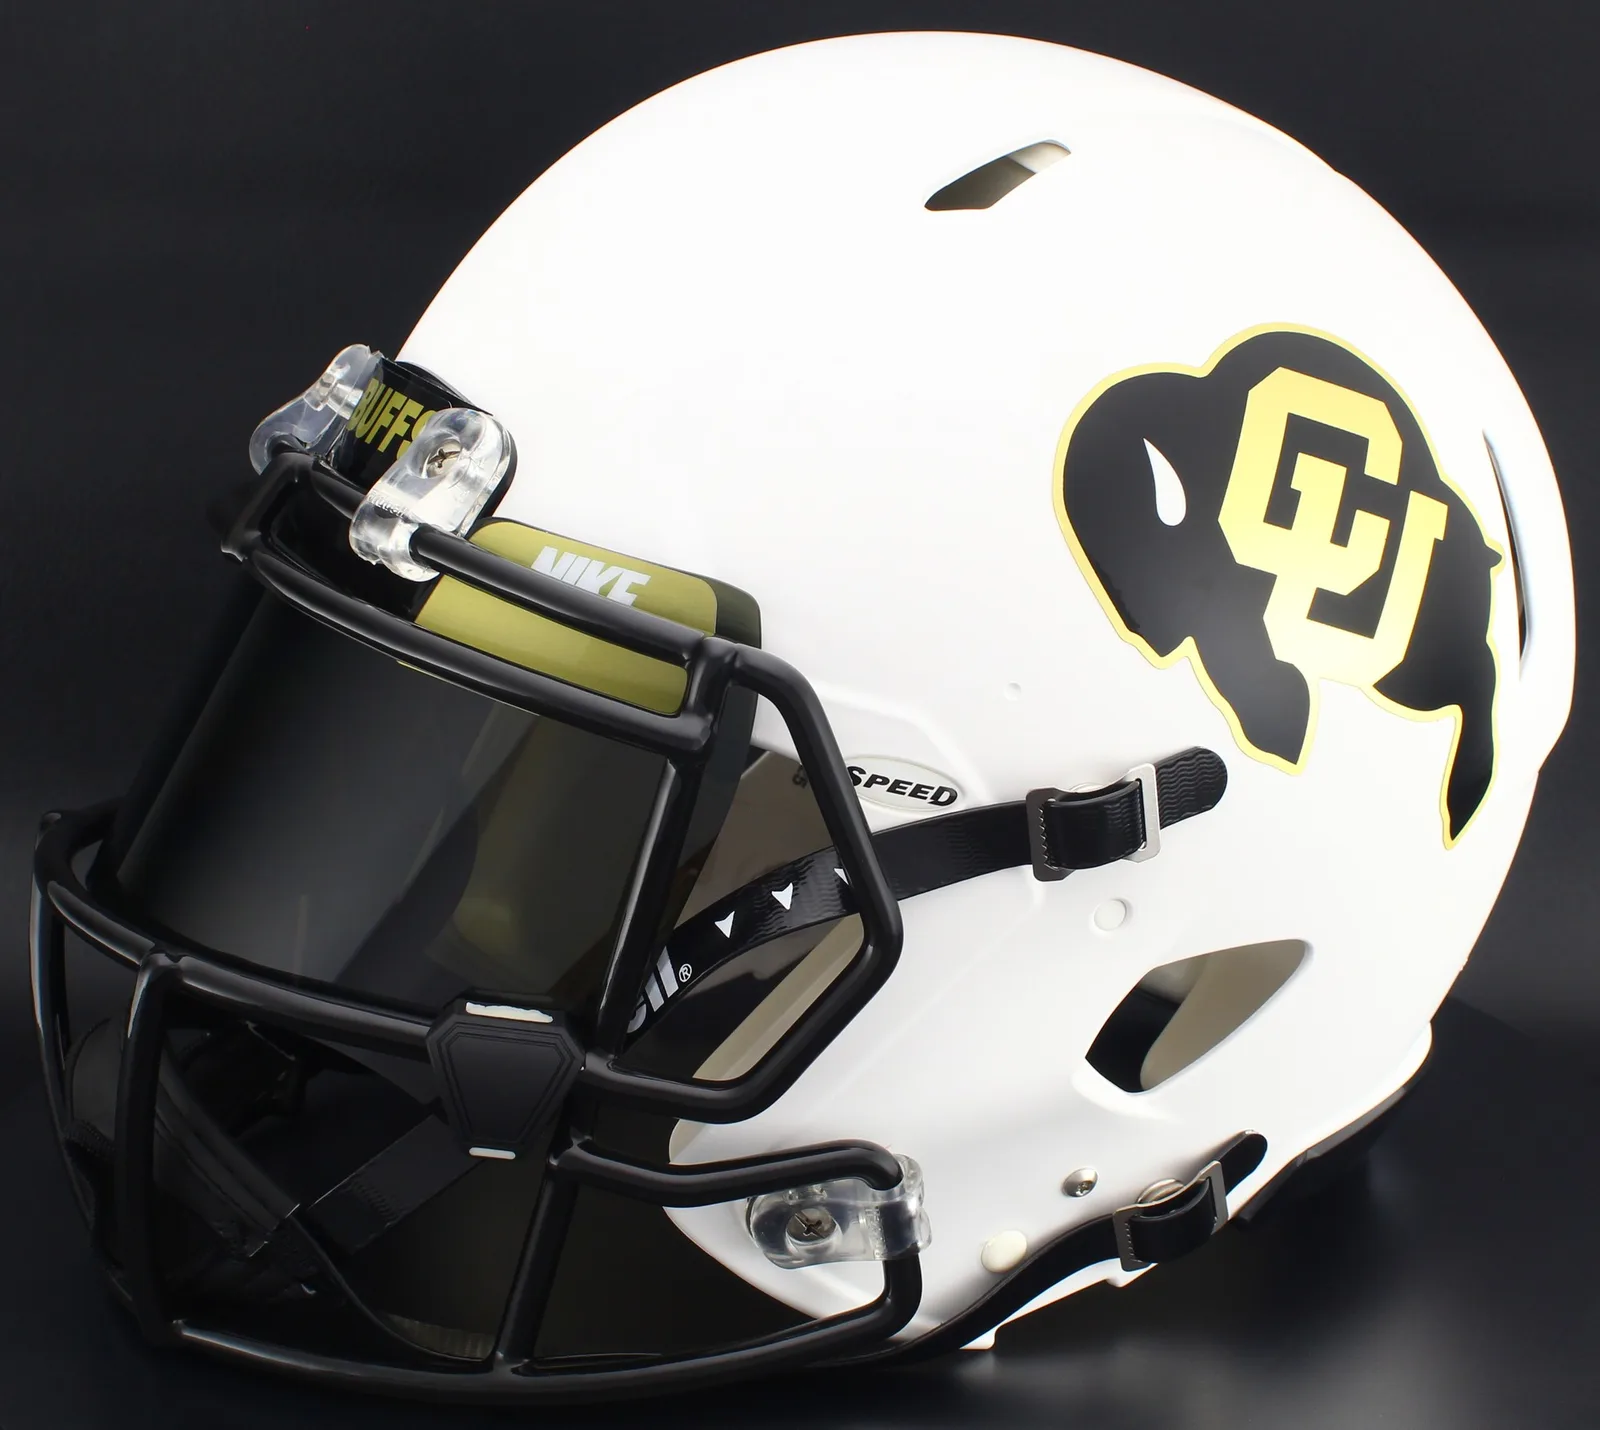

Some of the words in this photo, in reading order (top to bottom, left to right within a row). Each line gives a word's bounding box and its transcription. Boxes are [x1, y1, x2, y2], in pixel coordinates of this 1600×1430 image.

[1217, 366, 1448, 687] CU
[530, 543, 651, 606] NIKE
[847, 766, 958, 806] SPEED
